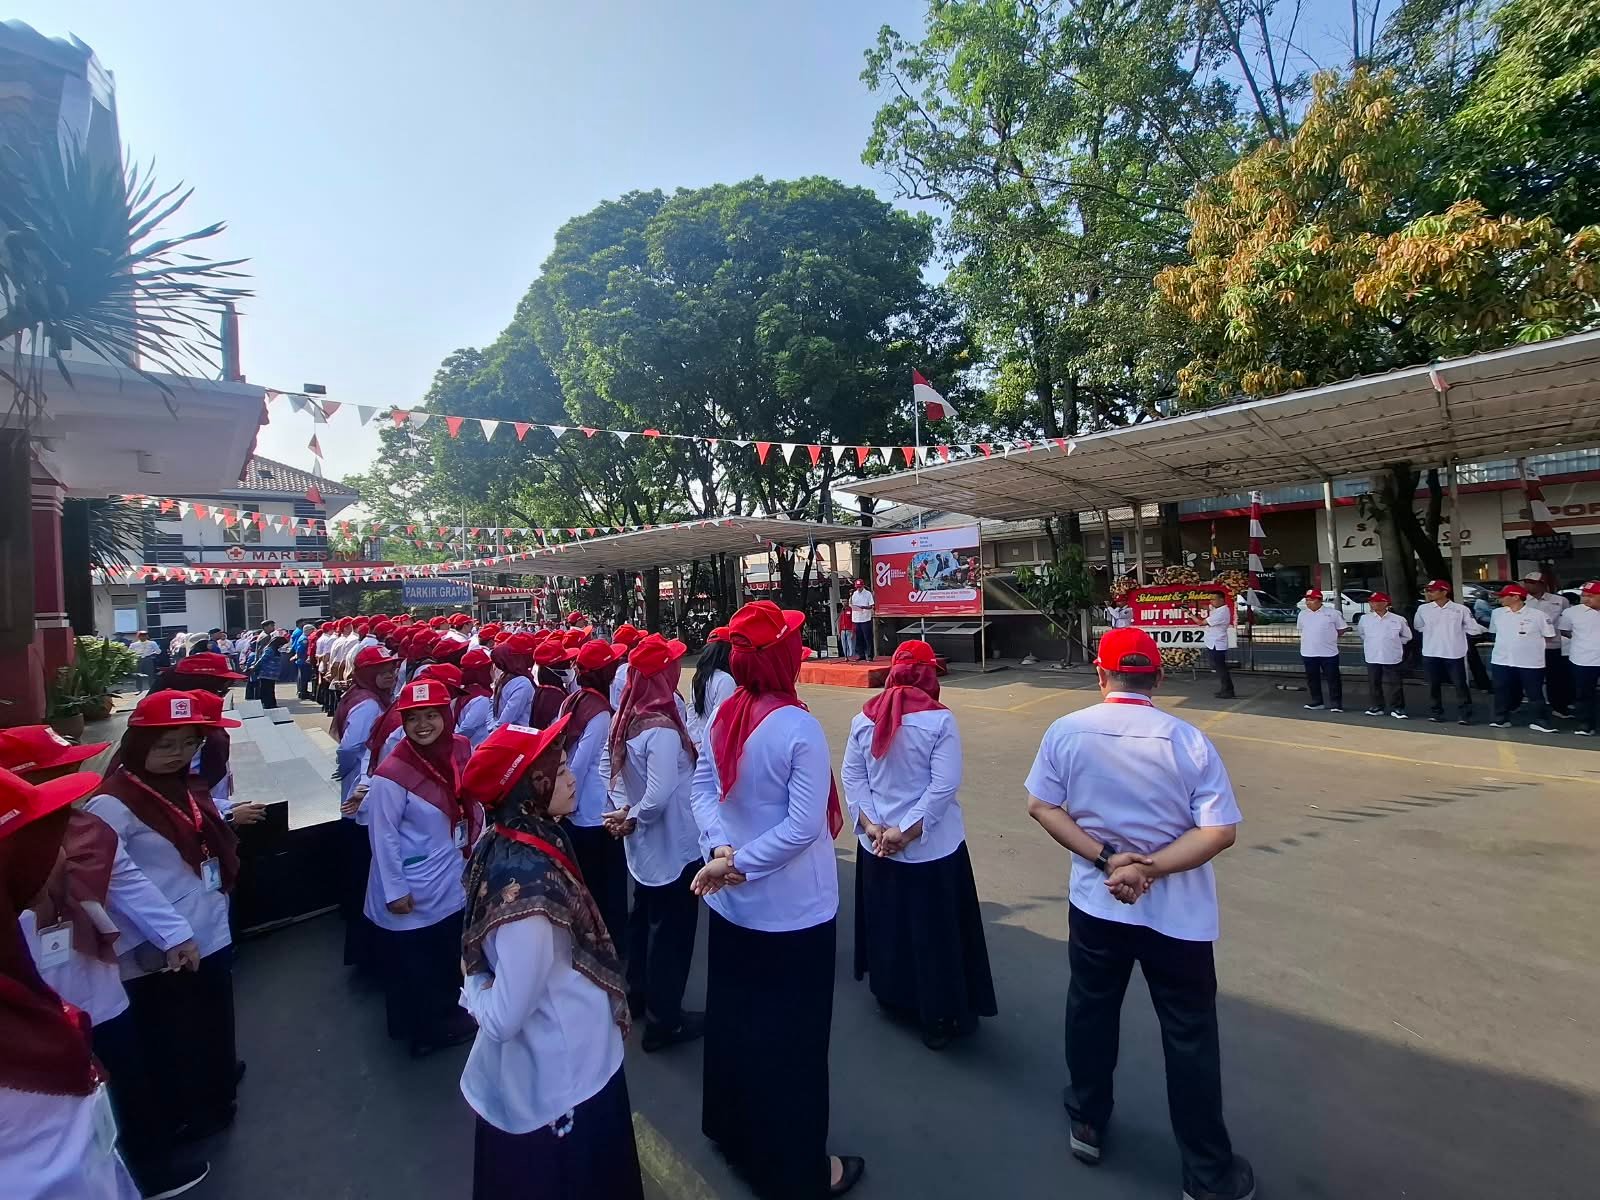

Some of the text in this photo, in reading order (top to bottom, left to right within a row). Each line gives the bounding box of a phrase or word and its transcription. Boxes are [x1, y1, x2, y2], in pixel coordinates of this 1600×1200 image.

[1201, 549, 1280, 560] SINETCA
[405, 586, 469, 598] PARKIR GRATIS
[1136, 593, 1172, 602] Selamat
[1141, 609, 1160, 620] HUT
[1162, 608, 1182, 619] PMI
[1146, 630, 1205, 643] TO/B2
